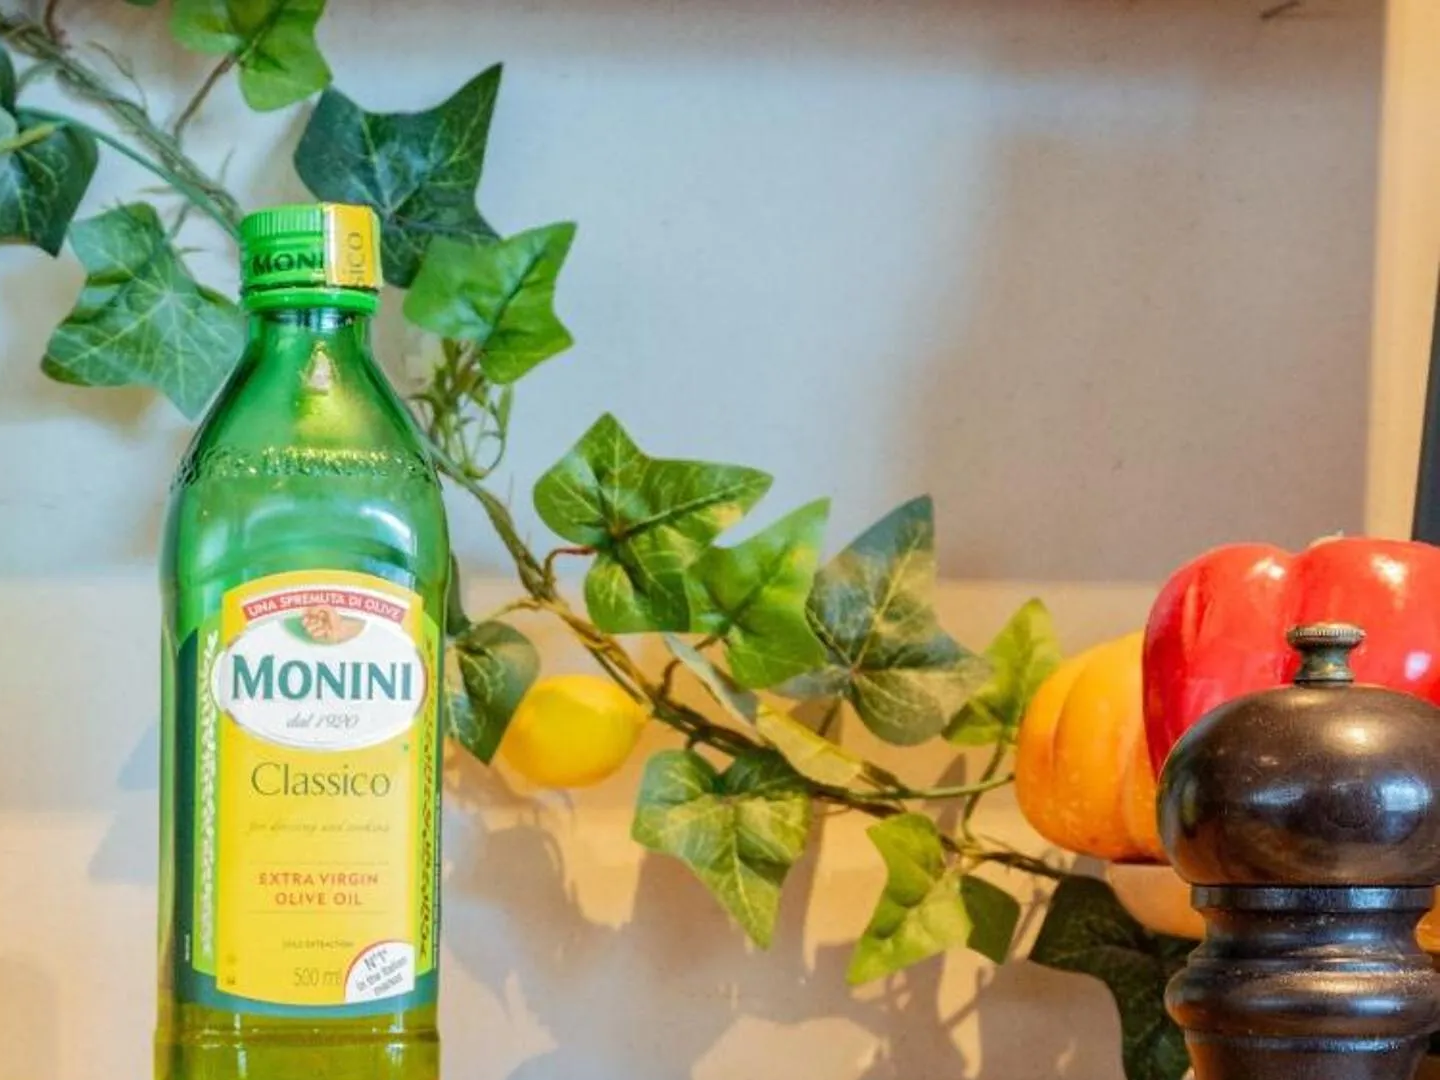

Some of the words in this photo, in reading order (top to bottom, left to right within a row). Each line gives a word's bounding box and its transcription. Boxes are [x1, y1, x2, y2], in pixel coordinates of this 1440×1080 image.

[252, 253, 324, 276] MONI
[232, 654, 412, 701] MONINI
[250, 761, 392, 797] Classico
[258, 872, 315, 886] EXTRA
[319, 872, 379, 886] VIRGIN
[275, 892, 327, 906] OLIVE
[333, 892, 364, 906] OIL
[293, 967, 319, 986] 500
